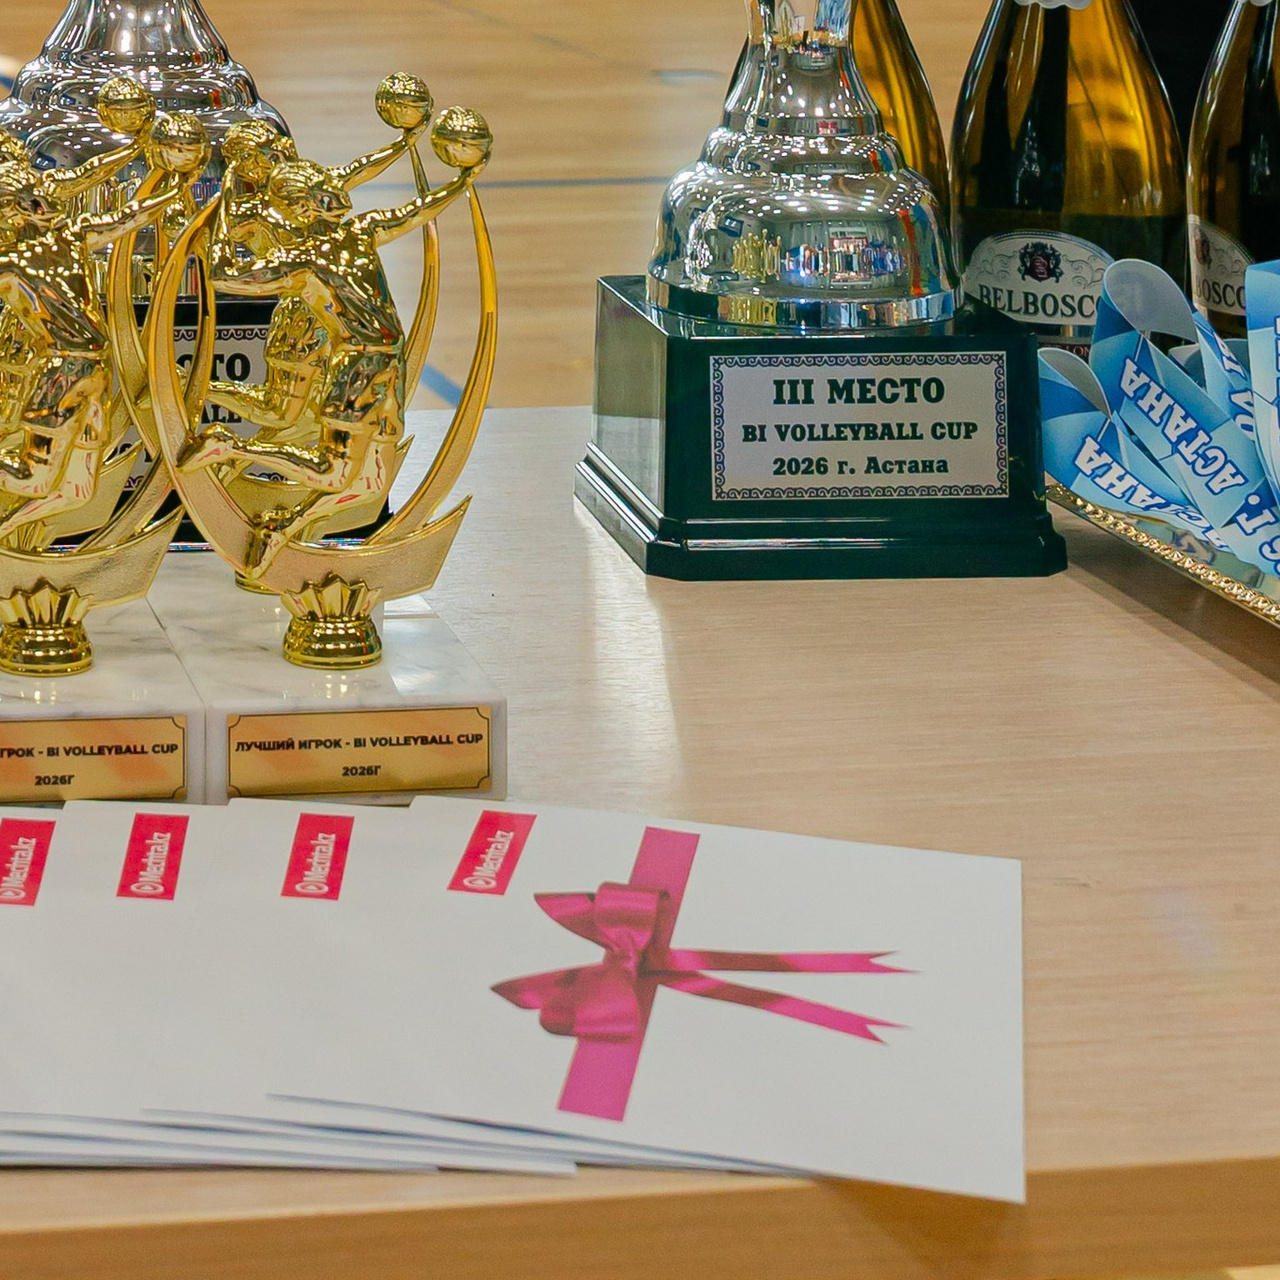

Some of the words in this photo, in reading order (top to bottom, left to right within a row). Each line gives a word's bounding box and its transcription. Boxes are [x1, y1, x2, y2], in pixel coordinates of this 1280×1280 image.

[978, 283, 1101, 318] BELBOSC
[772, 378, 815, 405] III
[827, 377, 945, 404] МЕСТО
[741, 424, 767, 442] BI
[774, 423, 924, 442] VOLLEYBALL
[930, 421, 978, 440] CUP
[1119, 356, 1249, 496] АСТАНА
[772, 456, 828, 476] 2026
[837, 459, 856, 475] г.
[865, 456, 949, 475] Астана
[46, 747, 60, 757] BI
[63, 744, 149, 756] VOLLEYBALL
[151, 743, 179, 754] CUP
[235, 737, 295, 752] ЛУЧШИЙ
[298, 738, 342, 750] ИГРОК
[353, 738, 366, 748] BI
[370, 734, 453, 748] VOLLEYBALL
[456, 733, 483, 745] CUP
